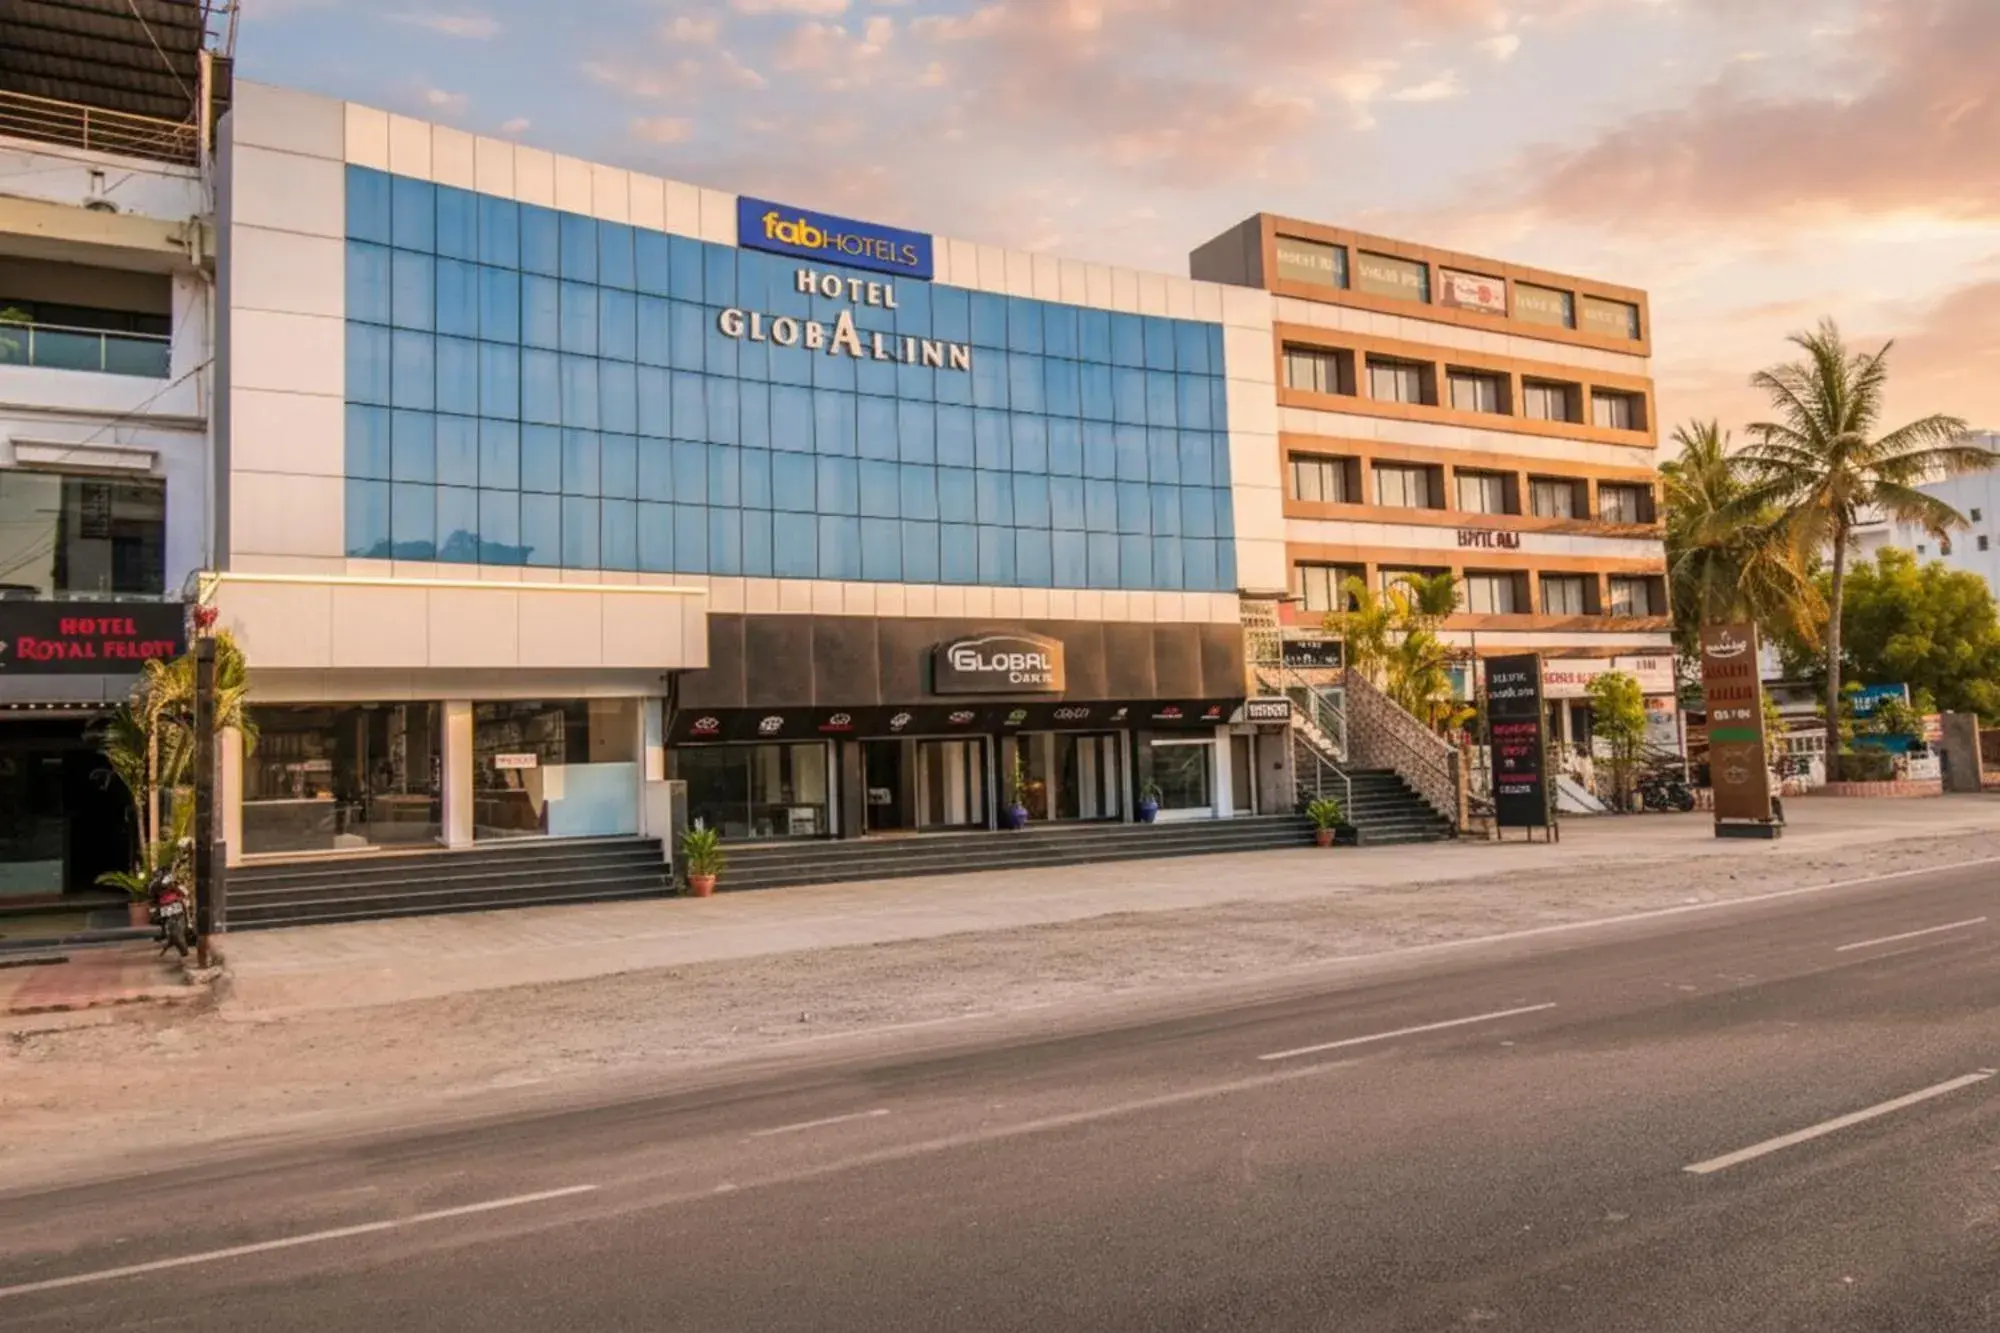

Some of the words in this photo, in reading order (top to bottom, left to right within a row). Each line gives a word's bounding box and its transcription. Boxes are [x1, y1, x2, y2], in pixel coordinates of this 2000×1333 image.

[762, 212, 918, 266] fabHOTELS
[796, 269, 899, 309] HOTEL
[719, 308, 889, 361] GLOBAL
[905, 337, 971, 372] INN
[60, 617, 137, 636] HOTEL
[17, 636, 97, 660] ROYAL
[954, 650, 1053, 672] GLOBAL
